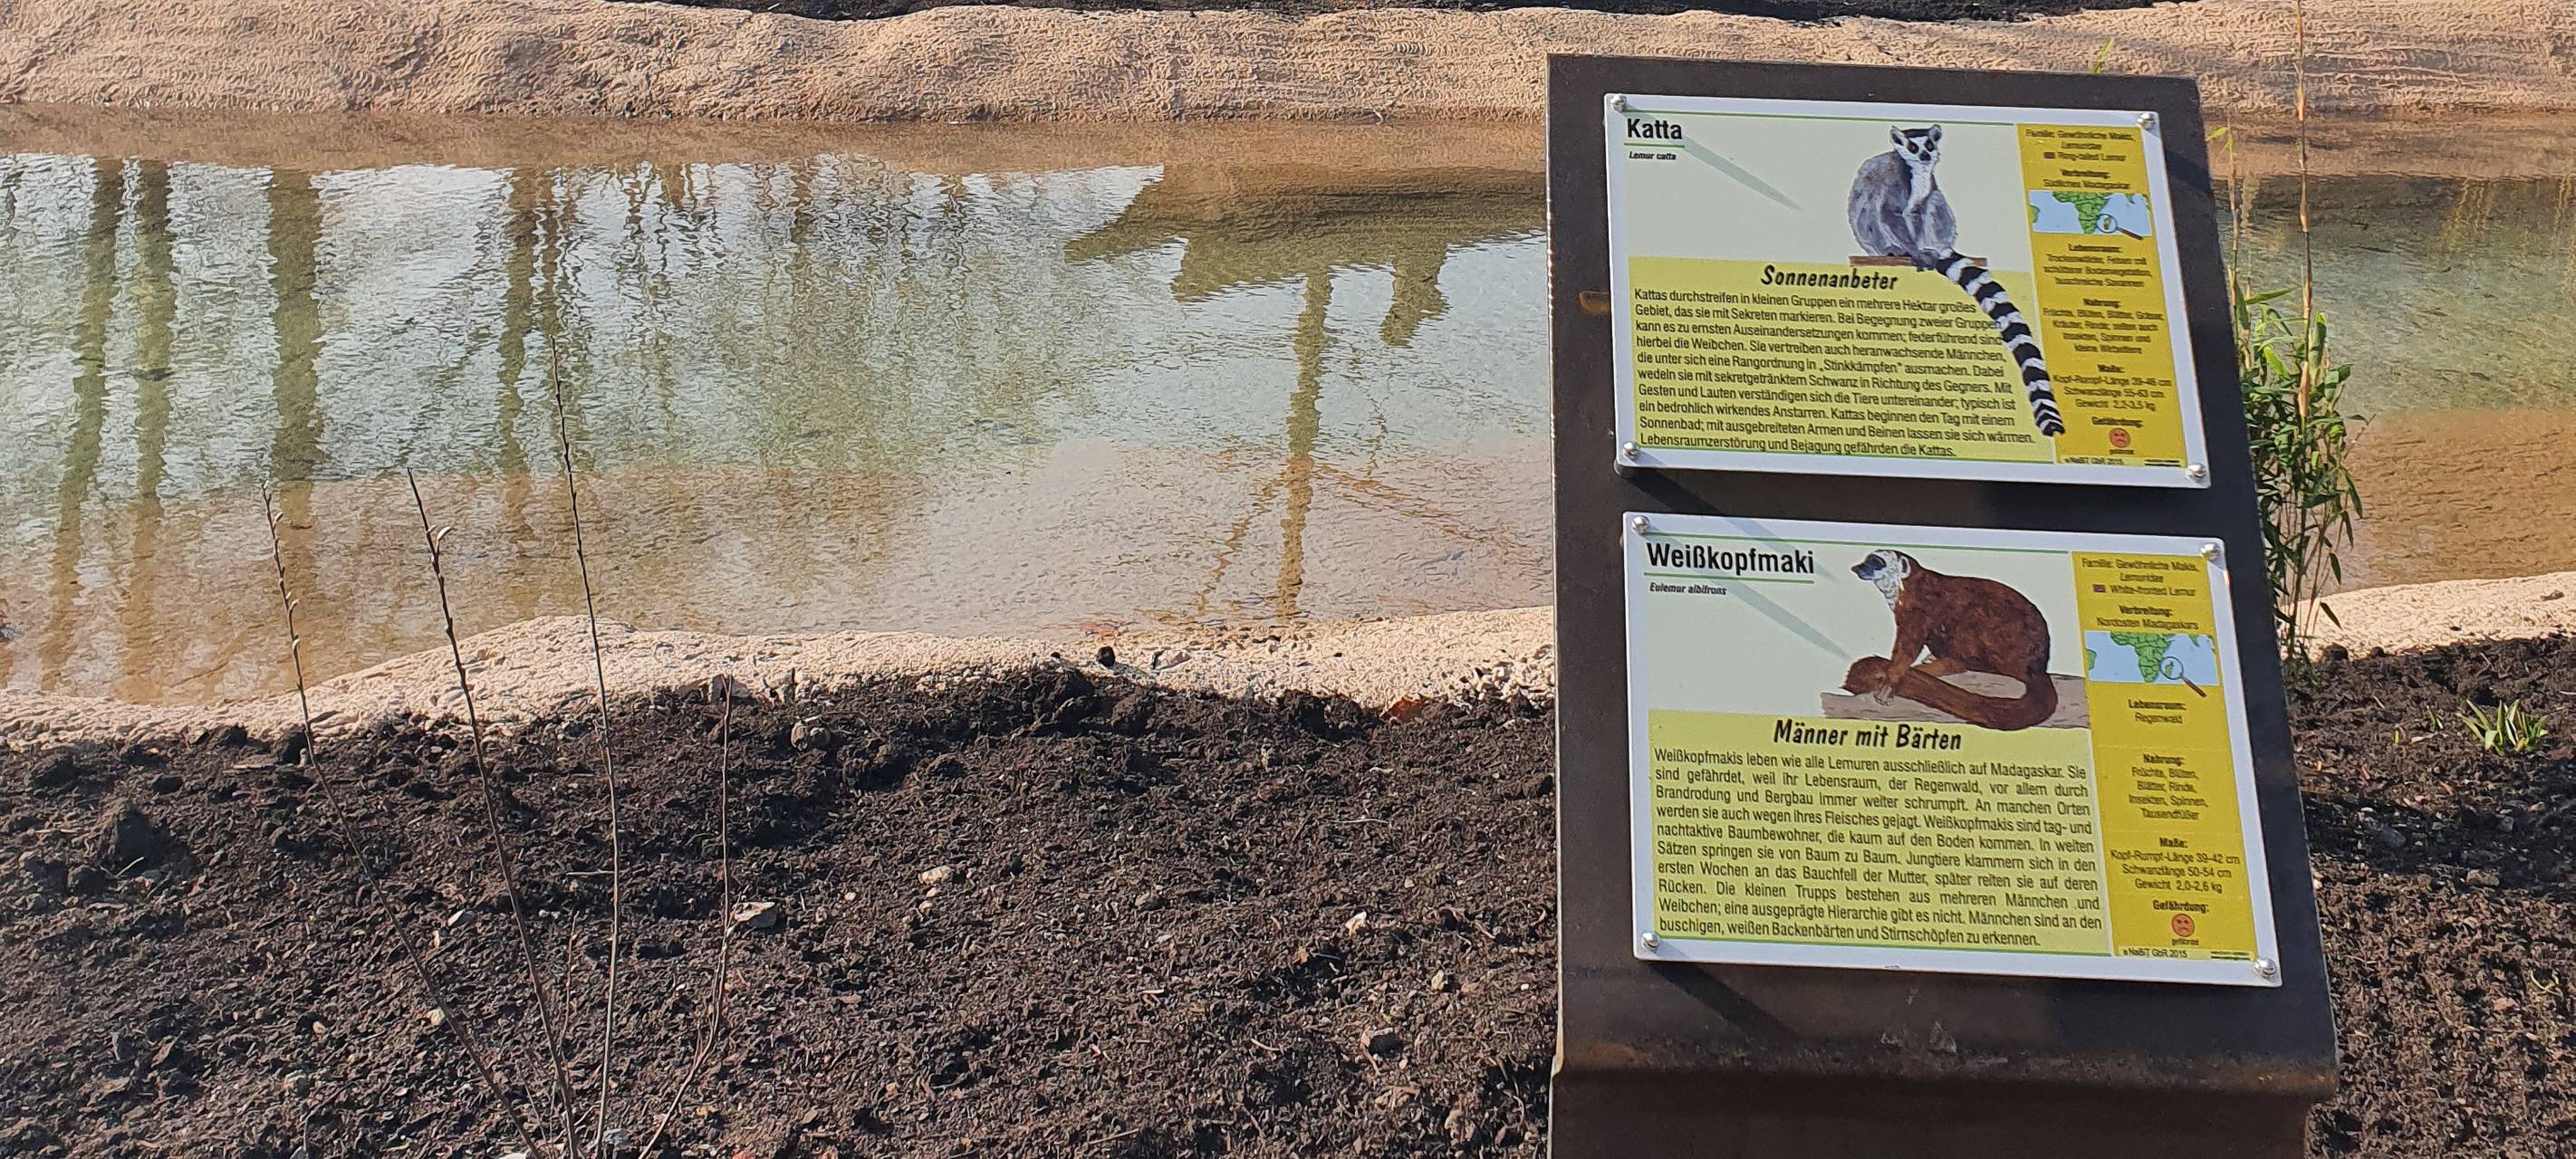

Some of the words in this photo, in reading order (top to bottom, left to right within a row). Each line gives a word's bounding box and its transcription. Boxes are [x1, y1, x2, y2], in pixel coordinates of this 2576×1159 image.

[1627, 118, 1682, 139] Katta
[1760, 264, 1898, 290] Sonnenanbeter
[1634, 287, 1667, 301] Kattas
[1669, 290, 1738, 303] durchstreifen
[1740, 292, 1750, 303] in
[1751, 292, 1789, 305] kleinen
[1790, 294, 1837, 308] Gruppen
[1838, 296, 1855, 308] ein
[1856, 298, 1900, 310] mehrere
[1901, 299, 1937, 311] Hektar
[1937, 301, 1976, 312] großes
[1636, 334, 1671, 348] hierbei
[1673, 337, 1689, 349] die
[1690, 337, 1747, 350] Weibchen.
[1749, 340, 1766, 351] Sie
[1767, 341, 1822, 354] vertreiben
[1823, 343, 1850, 355] auch
[1851, 344, 1944, 359] heranwachsende
[1946, 348, 2006, 362] Männchen,
[1638, 383, 1676, 397] Gesten
[1677, 385, 1697, 398] und
[1699, 386, 1736, 398] Lauten
[1737, 388, 1808, 403] verständigen
[1809, 390, 1832, 402] sich
[1833, 391, 1850, 404] die
[1850, 391, 1879, 405] Tiere
[1879, 394, 1959, 409] untereinander;
[1959, 397, 2000, 410] typisch
[2001, 398, 2016, 410] ist
[1639, 399, 1655, 412] ein
[1657, 400, 1714, 414] bedrohlich
[1715, 402, 1771, 417] wirkendes
[1772, 405, 1829, 418] Anstarren.
[1830, 407, 1865, 420] Kattas
[1866, 408, 1917, 424] beginnen
[1918, 411, 1939, 423] den
[1939, 412, 1960, 426] Tag
[1961, 413, 1980, 425] mit
[1981, 414, 2014, 426] einem
[1639, 416, 1704, 431] Sonnenbad;
[1706, 418, 1724, 431] mit
[1725, 420, 1805, 435] ausgebreiteten
[1806, 423, 1843, 436] Armen
[1845, 425, 1866, 436] und
[1867, 425, 1906, 437] Beinen
[1906, 427, 1943, 439] lassen
[1944, 428, 1960, 440] sie
[1961, 429, 1985, 441] sich
[1985, 430, 2035, 443] wärmen.
[1640, 433, 1765, 449] Lebensraumzerstörung
[1767, 438, 1788, 450] und
[1790, 438, 1841, 452] Bejagung
[1843, 441, 1898, 454] gefährden
[1899, 443, 1916, 455] die
[1918, 444, 1956, 456] Kattas.
[1646, 542, 1813, 576] Weißkopfmaki
[1773, 718, 1848, 745] Männer
[1855, 724, 1889, 747] mit
[1895, 723, 1961, 750] Bärten
[1654, 747, 1743, 765] Weißkopfmakis
[1746, 752, 1777, 766] leben
[1781, 753, 1801, 767] wie
[1804, 754, 1824, 768] alle
[1827, 755, 1879, 771] Lemuren
[1882, 759, 1966, 774] ausschließlich
[1969, 761, 1986, 775] auf
[1990, 761, 2064, 780] Madagaskar.
[2067, 764, 2086, 779] Sie
[1655, 766, 1679, 780] sind
[1687, 768, 1745, 785] gefährdet,
[1752, 771, 1775, 784] weil
[1782, 771, 1798, 785] ihr
[1804, 772, 1880, 790] Lebensraum,
[1888, 776, 1908, 790] der
[1914, 777, 1982, 795] Regenwald,
[1988, 782, 2009, 794] vor
[2015, 781, 2047, 795] allem
[2053, 782, 2088, 797] durch
[1656, 784, 1730, 803] Brandrodung
[1736, 789, 1759, 802] und
[1764, 789, 1812, 806] Bergbau
[1819, 791, 1858, 806] immer
[1861, 794, 1898, 808] weiter
[1904, 795, 1968, 812] schrumpft.
[1975, 798, 1991, 811] An
[1996, 800, 2051, 814] manchen
[2056, 800, 2090, 815] Orten
[1656, 804, 1699, 818] werden
[1702, 805, 1718, 819] sie
[1721, 807, 1750, 820] auch
[1752, 809, 1791, 824] wegen
[1793, 809, 1821, 823] ihres
[1824, 809, 1879, 826] Fleisches
[1881, 813, 1921, 829] gejagt.
[1923, 814, 2014, 832] Weißkopfmakis
[2015, 818, 2041, 832] sind
[2043, 819, 2067, 836] tag-
[2069, 820, 2092, 834] und
[1657, 822, 1722, 838] nachtaktive
[1727, 824, 1821, 844] Baumbewohner,
[1827, 829, 1845, 843] die
[1849, 829, 1882, 845] kaum
[1887, 831, 1905, 845] auf
[1909, 832, 1932, 847] den
[1936, 833, 1975, 848] Boden
[1978, 835, 2034, 850] kommen.
[2039, 838, 2051, 851] In
[2053, 838, 2094, 853] weiten
[1657, 840, 1696, 855] Sätzen
[1701, 843, 1752, 859] springen
[1756, 844, 1773, 858] sie
[1778, 848, 1800, 860] von
[1805, 847, 1840, 861] Baum
[1843, 851, 1858, 862] zu
[1862, 848, 1901, 864] Baum.
[1905, 850, 1960, 868] Jungtiere
[1964, 853, 2024, 868] klammern
[2028, 856, 2053, 869] sich
[2057, 857, 2069, 870] in
[2073, 857, 2095, 871] den
[2225, 856, 2240, 864] cm
[1658, 860, 1694, 875] ersten
[1699, 860, 1748, 876] Wochen
[1754, 866, 1769, 877] an
[1774, 864, 1796, 878] das
[1802, 865, 1857, 881] Bauchfell
[1862, 867, 1882, 882] der
[1888, 868, 1928, 886] Mutter,
[1934, 871, 1973, 887] später
[1977, 873, 2011, 887] reiten
[2016, 874, 2033, 888] sie
[2039, 876, 2058, 889] auf
[2063, 876, 2098, 891] deren
[2216, 869, 2232, 877] cm
[2210, 881, 2223, 894] kg
